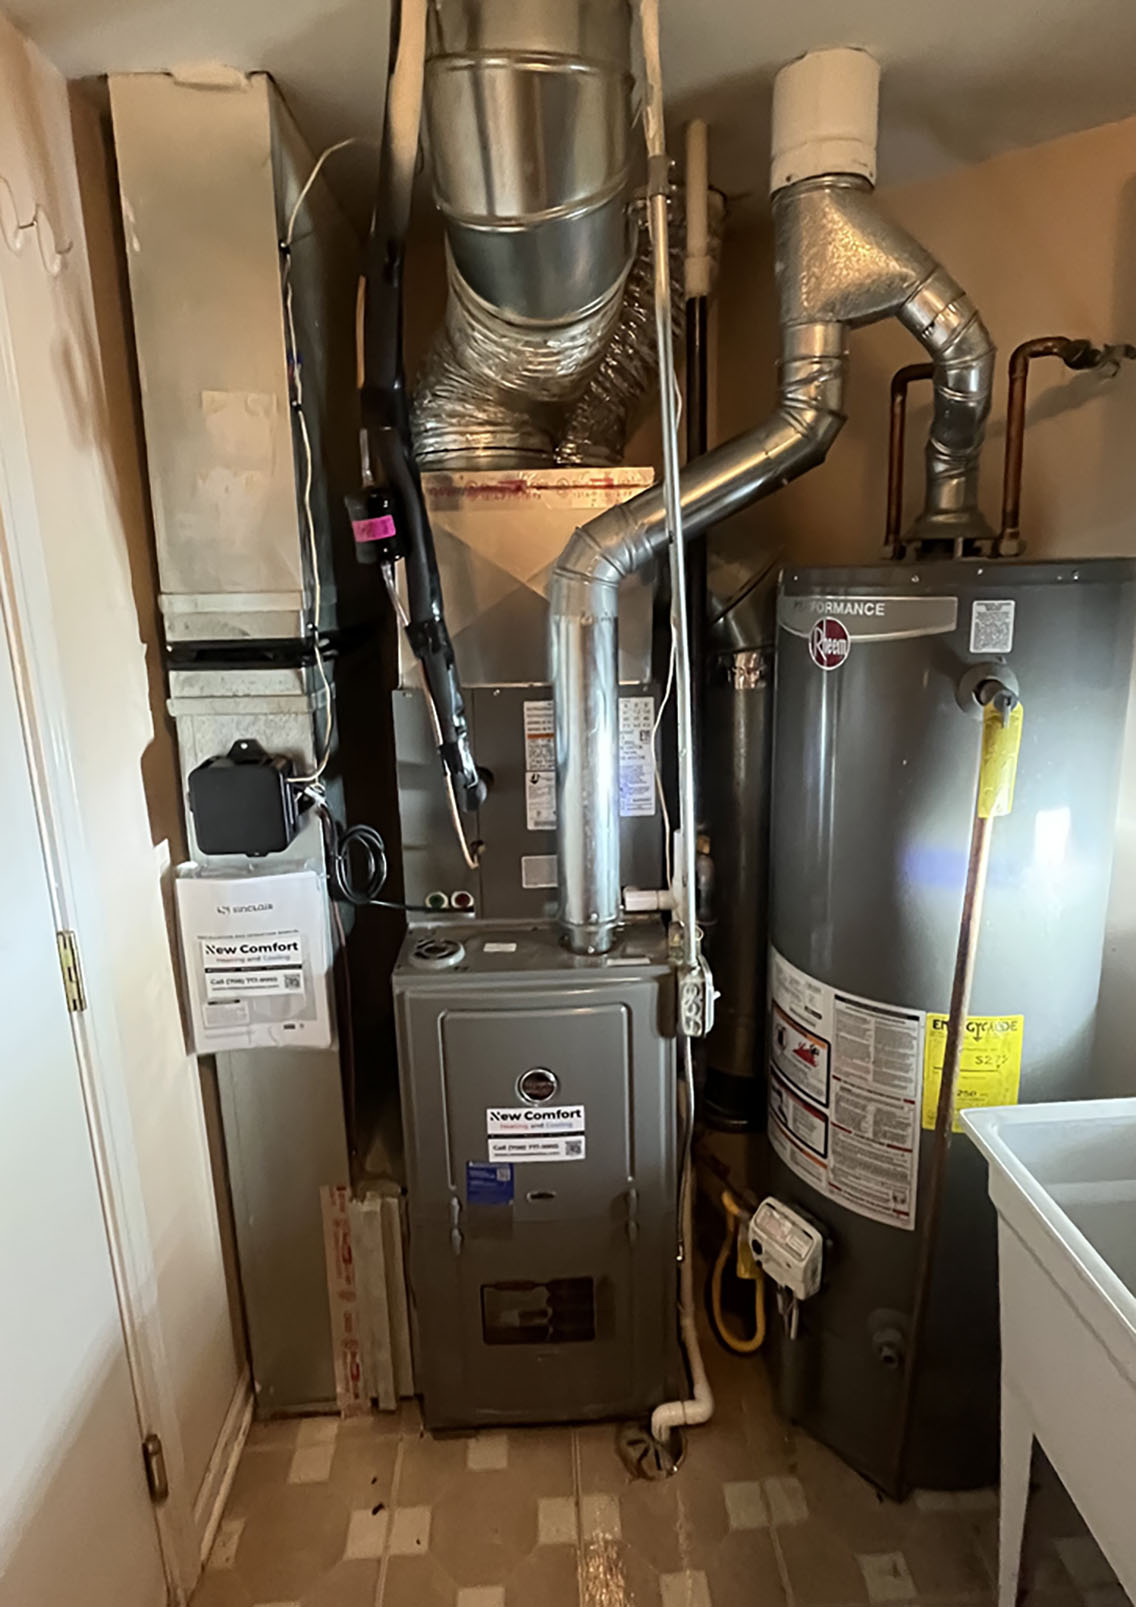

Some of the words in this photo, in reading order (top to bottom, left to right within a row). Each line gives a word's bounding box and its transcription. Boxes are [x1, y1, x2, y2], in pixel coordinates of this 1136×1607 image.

[814, 620, 848, 662] Rheem
[205, 944, 237, 955] New
[239, 942, 299, 954] Comfort
[490, 1111, 522, 1122] New
[524, 1109, 582, 1121] Comfort
